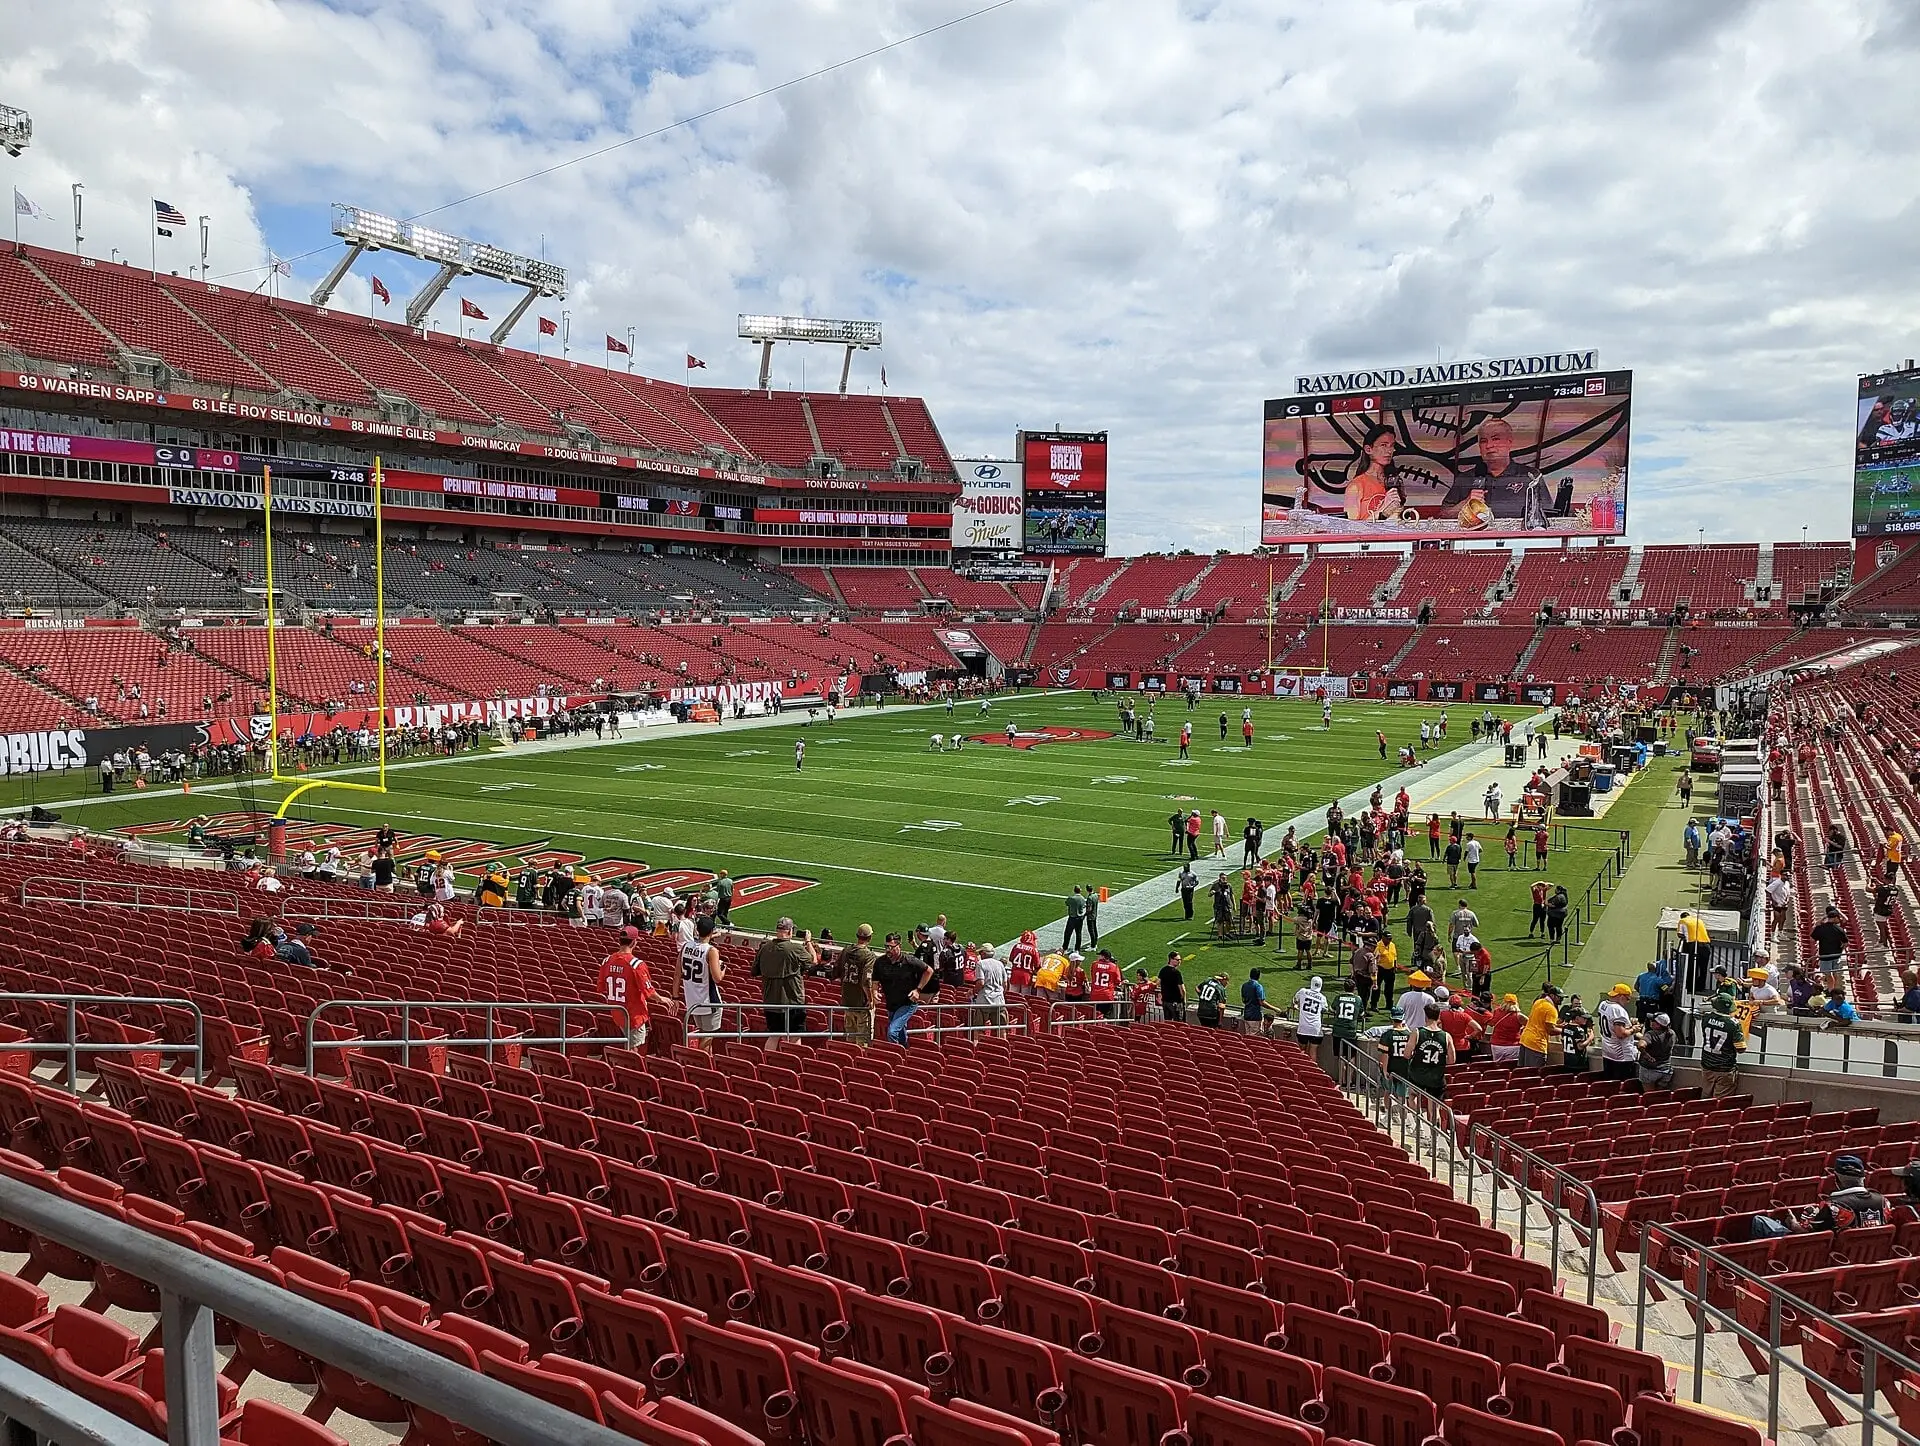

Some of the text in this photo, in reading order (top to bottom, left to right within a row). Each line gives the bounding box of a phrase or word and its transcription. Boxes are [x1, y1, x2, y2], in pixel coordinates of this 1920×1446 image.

[80, 257, 96, 267] 336
[1296, 352, 1594, 394] RAYMOND JAMES STADIUM
[18, 374, 155, 402] 99 WARREN SAPP
[1588, 382, 1602, 392] 25
[1876, 378, 1885, 386] 27
[1554, 386, 1584, 396] 73:48
[192, 398, 322, 426] 63 LEE ROY SELMON
[1315, 402, 1325, 412] 0
[1364, 398, 1374, 410] 0
[351, 420, 436, 442] 88 JIMMIE GILES
[12, 433, 34, 452] THE
[36, 434, 70, 455] GAME
[462, 436, 521, 452] JOHN MCKAY
[1050, 445, 1082, 454] COMMERCIAL
[180, 450, 190, 462] 0
[223, 454, 233, 466] 0
[544, 448, 618, 466] 12 DOUG WILLIAMS
[1050, 454, 1082, 470] BREAK
[636, 460, 699, 476] MALCOLM GLAZER
[330, 470, 364, 482] 73:48
[715, 470, 766, 485] 74 PAUL GRUBER
[1050, 472, 1080, 481] Mosaic
[443, 478, 556, 502] OPEN UNTIL 1 HOUR AFTER THE GAME
[804, 480, 860, 490] TONY DUNGY
[172, 490, 258, 510] RAYMOND
[314, 500, 375, 518] STADIUM
[617, 496, 648, 510] TEAM STORE
[970, 496, 1022, 514] #GOBUCS
[714, 506, 742, 520] TEAM STORE
[800, 512, 816, 522] OPEN
[816, 512, 836, 524] UNTIL
[840, 512, 858, 524] HOUR
[858, 513, 878, 524] AFTER
[878, 514, 890, 524] THE
[890, 514, 908, 525] GAME
[964, 524, 1012, 546] Miller
[989, 538, 1011, 546] TIME
[1140, 608, 1202, 620] BUCCANEERS
[419, 870, 428, 882] 12
[434, 878, 446, 889] 12
[520, 876, 527, 888] 9
[682, 946, 704, 984] BRADY 52
[954, 956, 964, 970] 12
[1013, 952, 1032, 970] 40
[1042, 958, 1062, 972] 47
[1094, 972, 1110, 987] 12
[606, 976, 626, 1002] 12
[1200, 984, 1216, 1000] 10
[1302, 998, 1320, 1014] 23
[1338, 1002, 1355, 1020] 12
[1734, 1005, 1750, 1020] 33
[1704, 1018, 1728, 1054] ADAMS 17
[1392, 1042, 1406, 1057] 12
[1563, 1036, 1575, 1054] 12
[1422, 1050, 1440, 1064] 34
